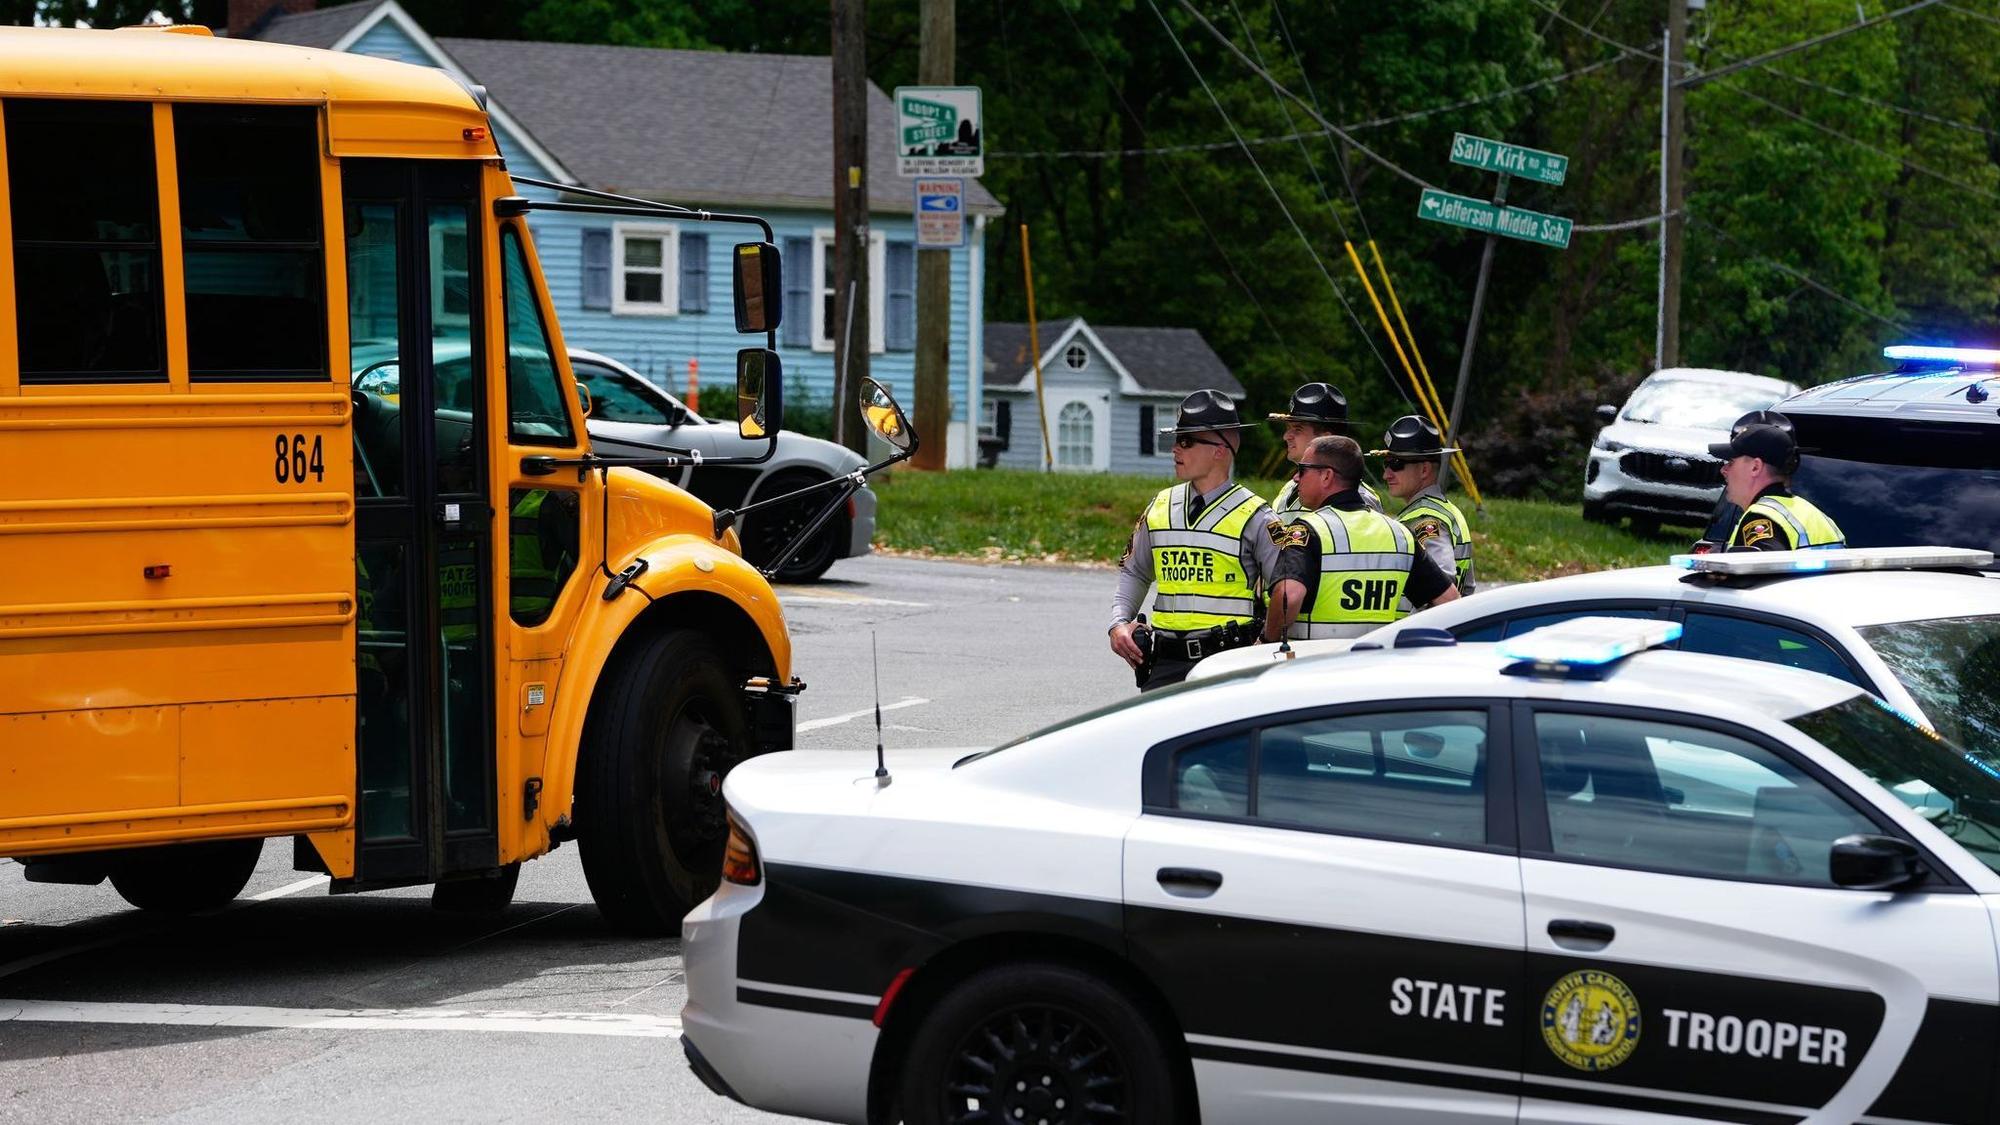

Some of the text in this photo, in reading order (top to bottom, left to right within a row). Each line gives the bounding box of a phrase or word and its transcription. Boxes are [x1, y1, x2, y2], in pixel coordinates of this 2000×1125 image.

[908, 103, 952, 120] ADOPT A
[913, 126, 947, 141] STREET
[1455, 137, 1492, 166] Sally
[1494, 146, 1526, 171] Kirk
[1547, 157, 1561, 169] NW
[918, 183, 961, 193] WARNING
[1540, 167, 1563, 183] 3500
[1436, 198, 1566, 243] Jefferson Middle Sch.
[275, 434, 325, 484] 864
[1161, 551, 1214, 567] STATE
[1162, 567, 1214, 583] TROOPER
[1340, 579, 1398, 611] SHP
[1390, 977, 1505, 1027] STATE
[1547, 973, 1638, 1018] NORTH CAROLINA
[1545, 1027, 1634, 1070] HIGHWAY PATROL
[1663, 1008, 1848, 1067] TROOPER
